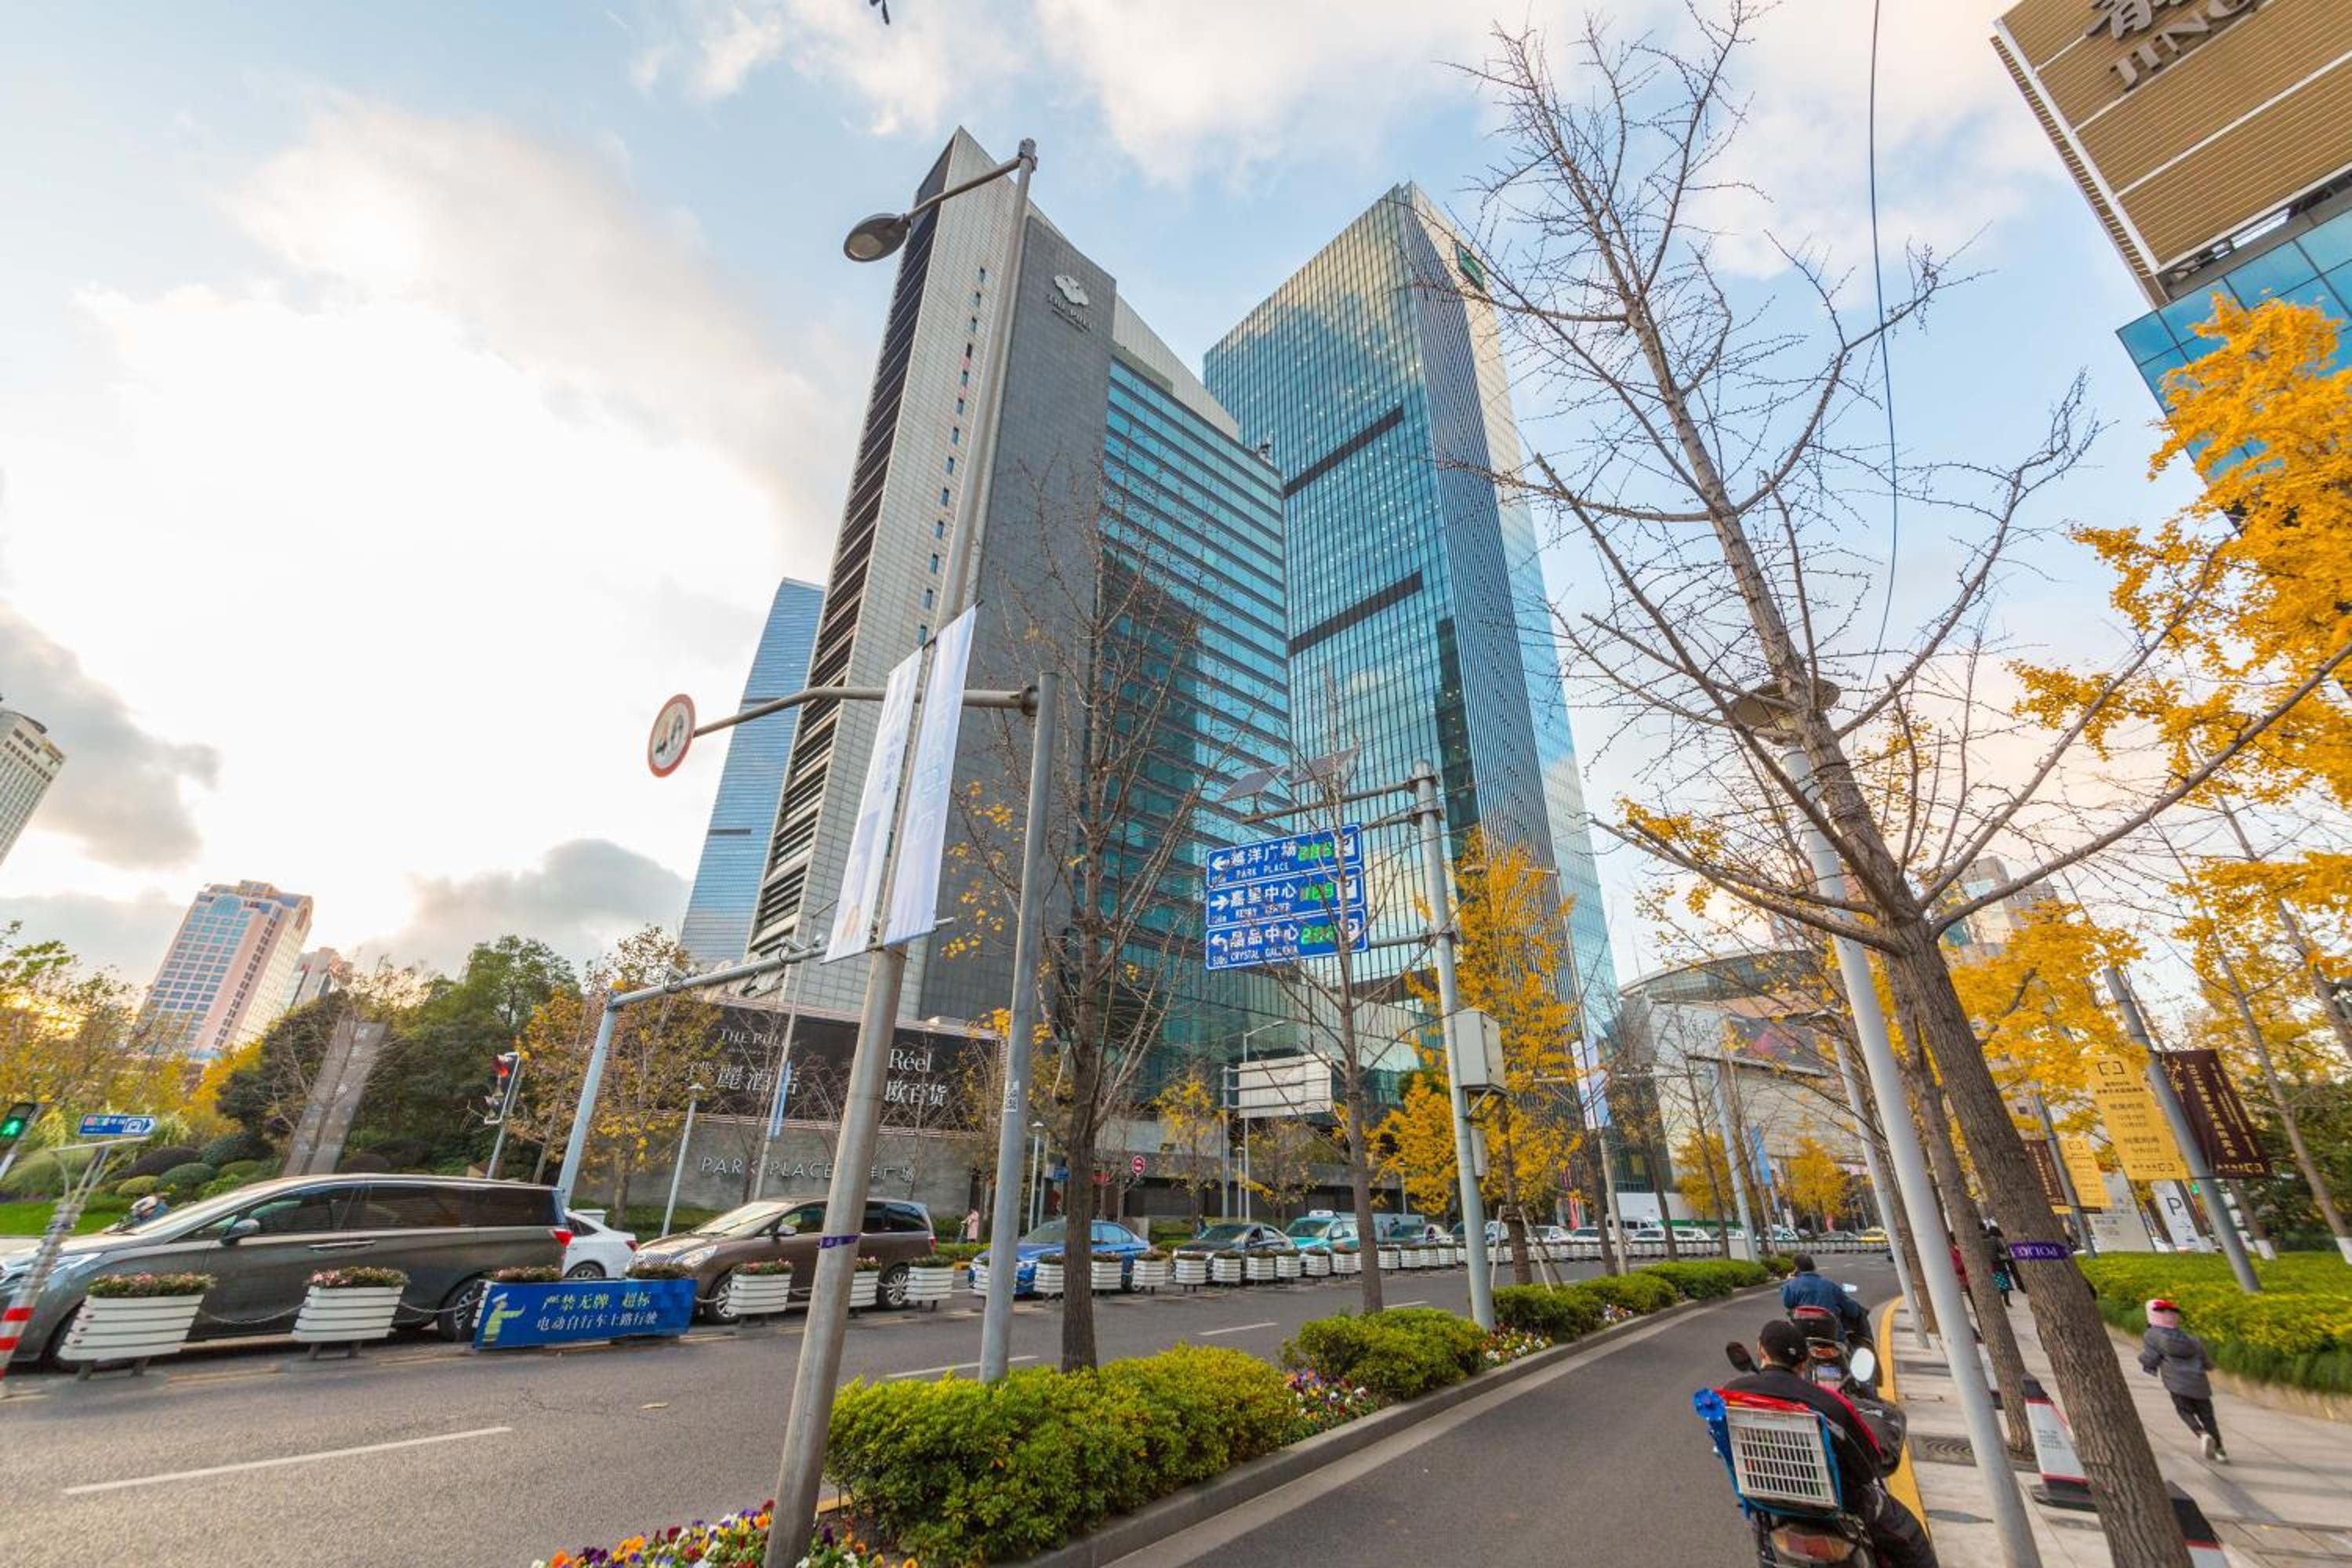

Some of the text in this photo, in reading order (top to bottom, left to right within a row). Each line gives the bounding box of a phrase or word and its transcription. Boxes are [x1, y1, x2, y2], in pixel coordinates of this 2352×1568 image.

[1264, 863, 1290, 875] PLACE
[720, 1028, 783, 1047] THE PUL
[887, 1048, 932, 1073] Réel
[768, 1160, 833, 1179] PLACE
[2166, 1197, 2182, 1216] P
[537, 1310, 658, 1330] 电动自行车上路行驶
